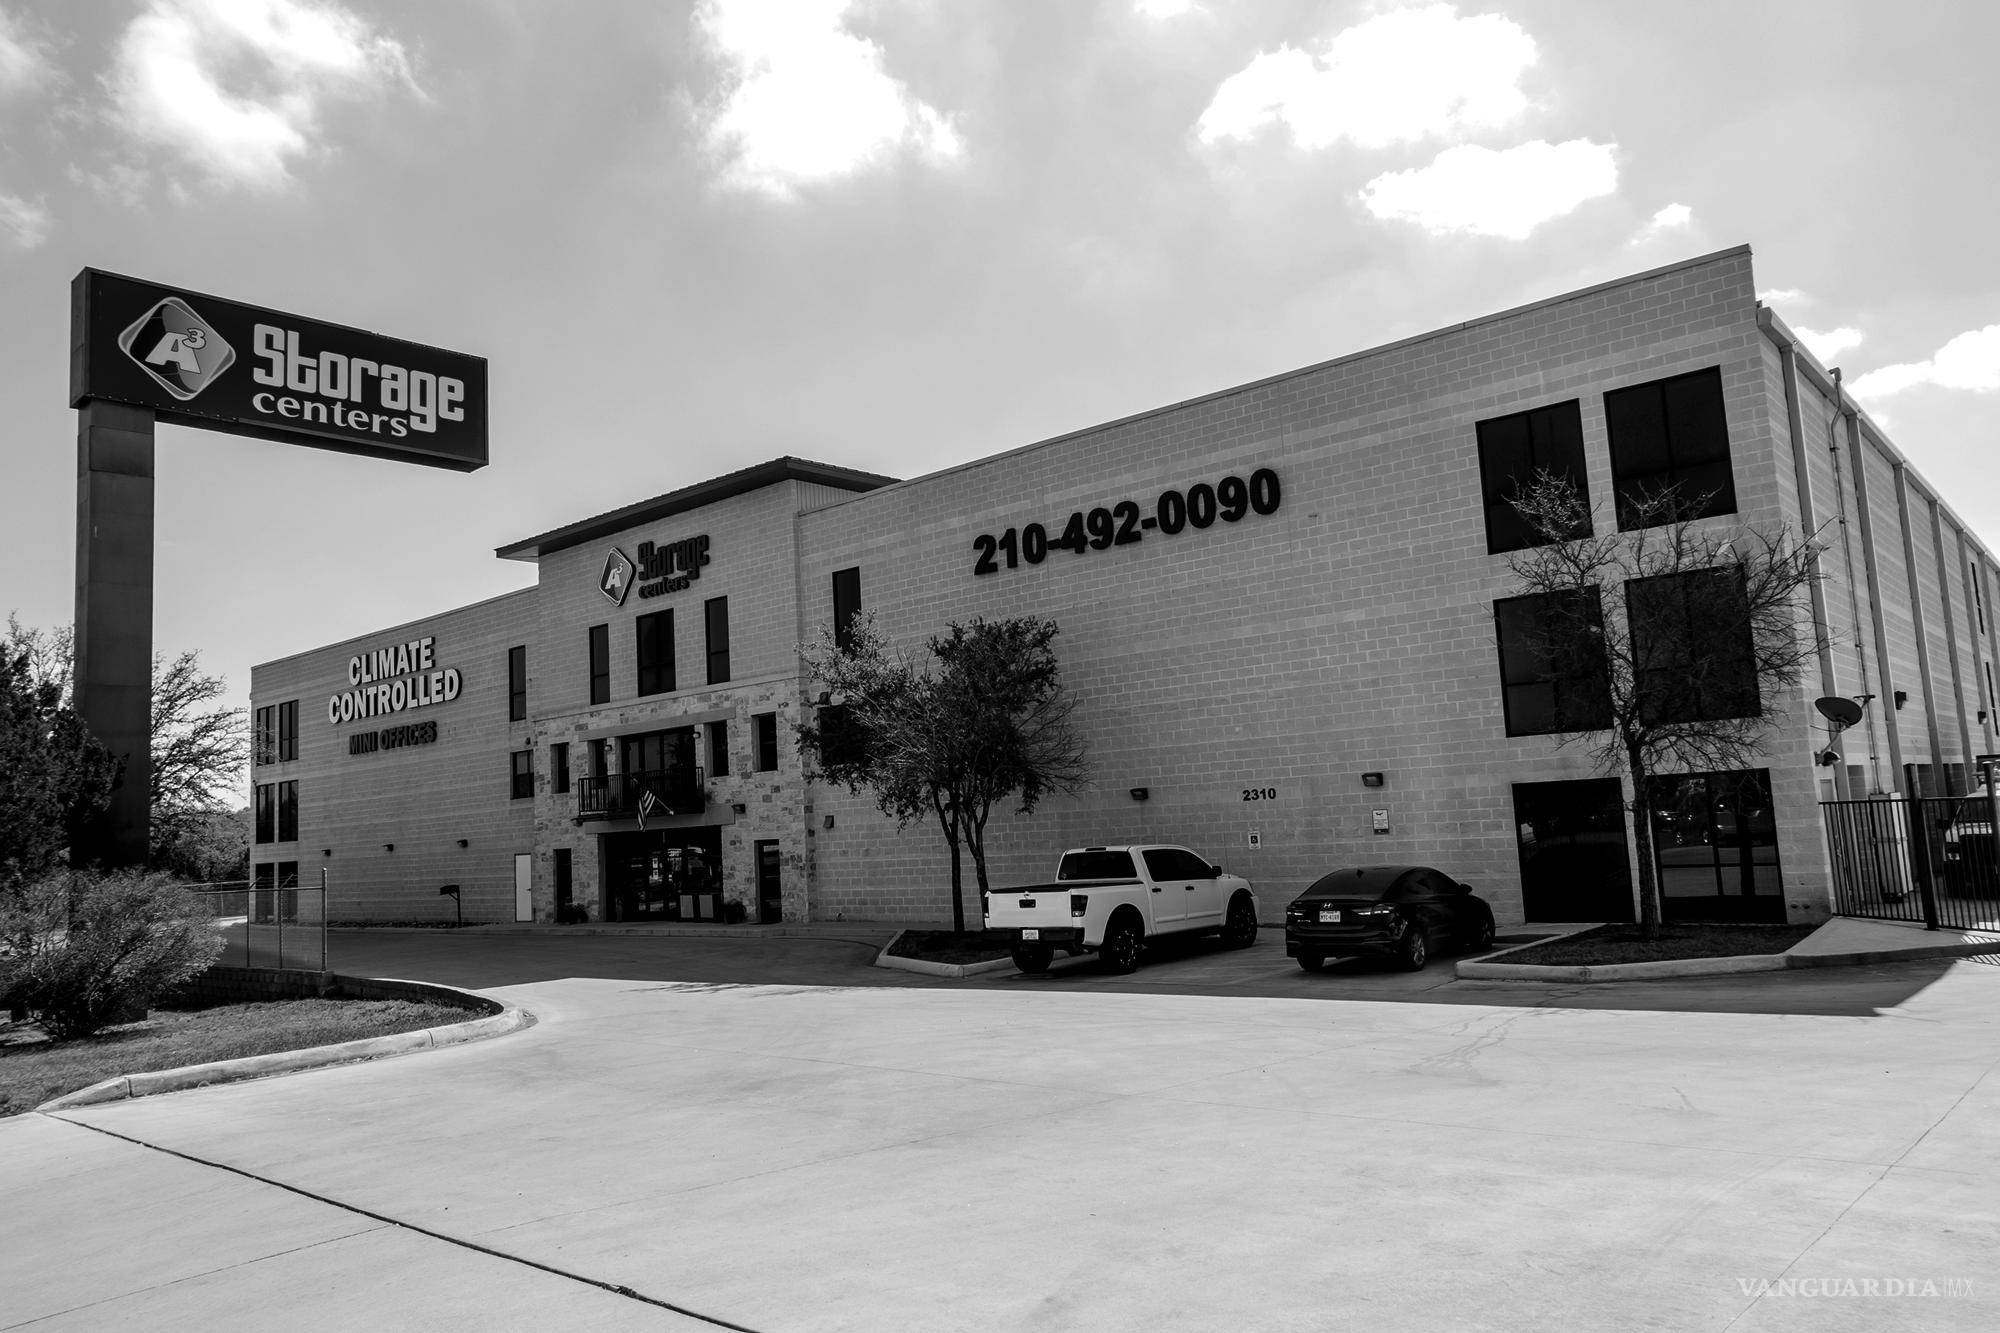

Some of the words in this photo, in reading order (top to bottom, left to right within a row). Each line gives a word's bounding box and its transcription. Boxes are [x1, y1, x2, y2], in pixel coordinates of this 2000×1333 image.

[253, 323, 464, 433] Storage
[252, 392, 408, 438] centers
[973, 468, 1281, 576] 210-492-0090
[638, 534, 710, 581] Storage
[638, 576, 691, 599] centers
[349, 636, 435, 686] CLIMATE
[328, 668, 462, 724] CONTROLLED
[349, 731, 379, 755] MINI
[379, 721, 438, 750] OFFICES
[1242, 788, 1276, 801] 2310
